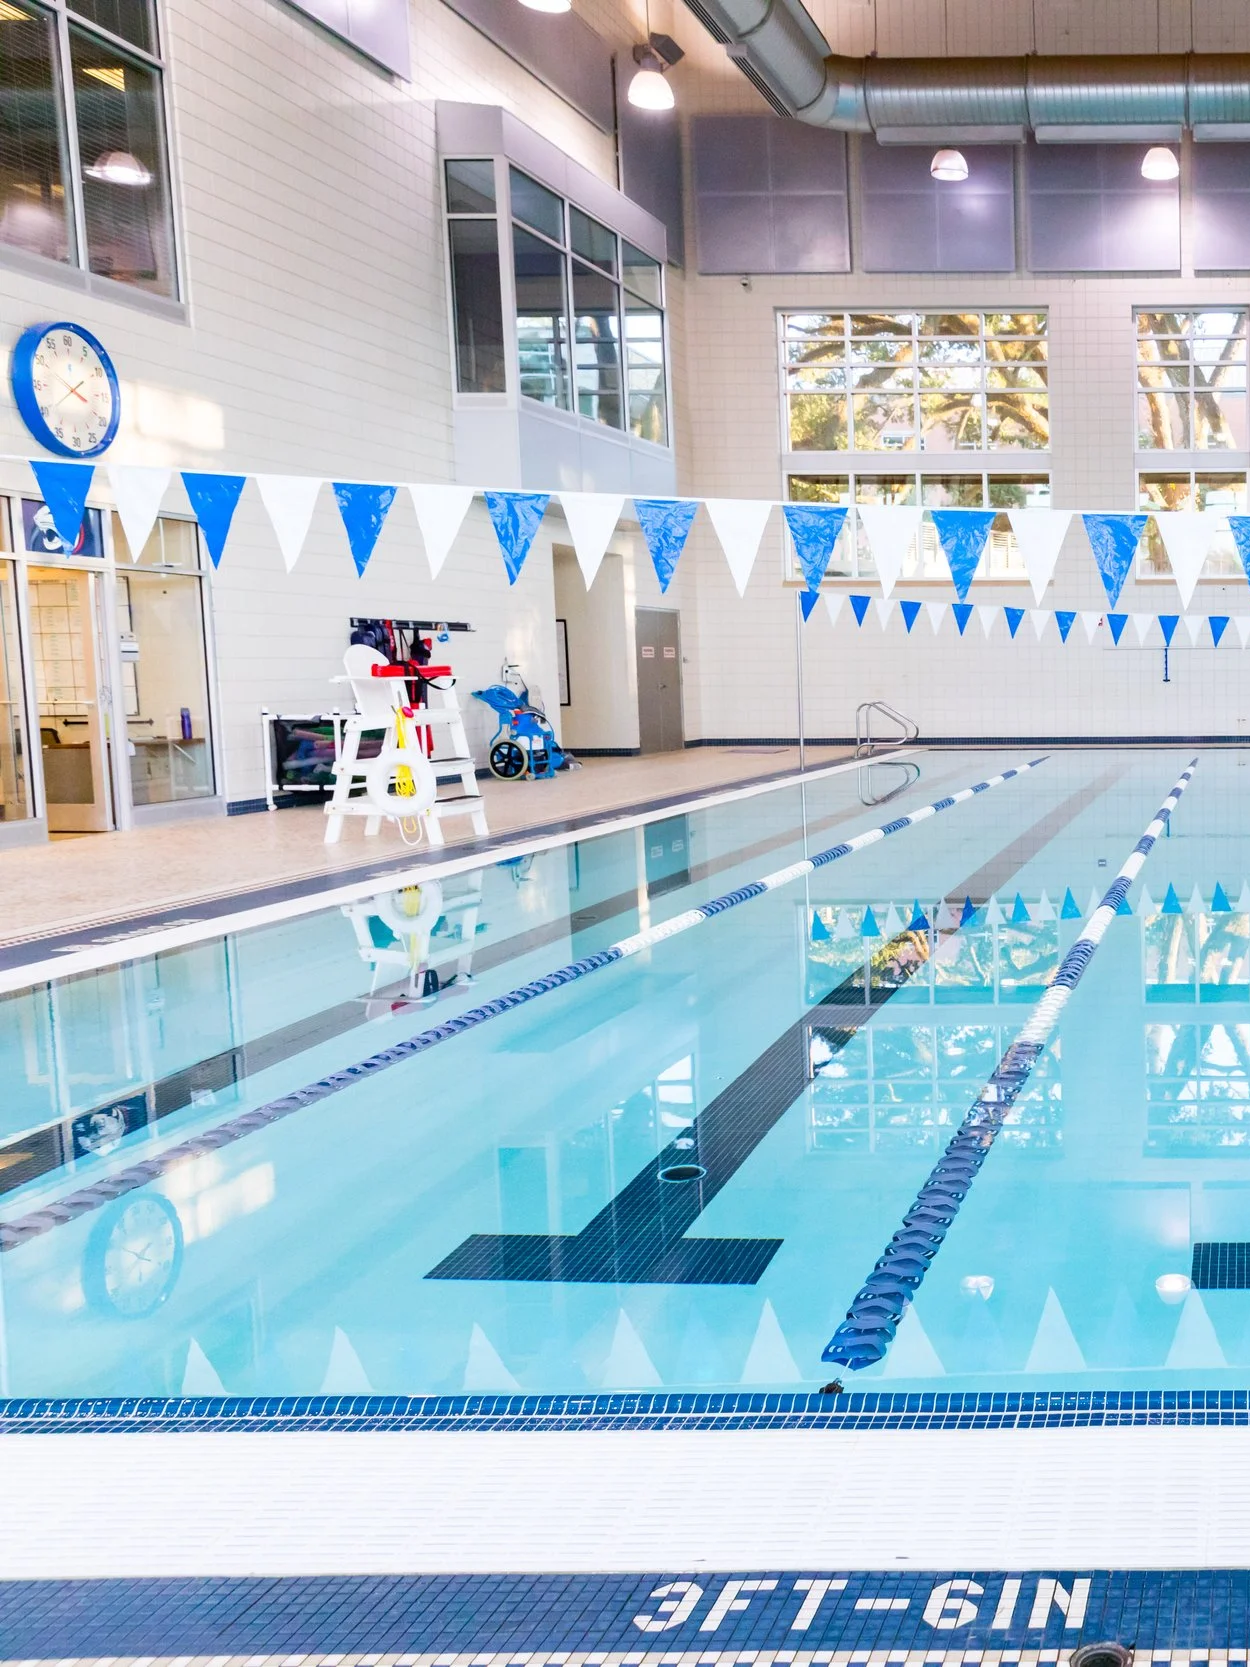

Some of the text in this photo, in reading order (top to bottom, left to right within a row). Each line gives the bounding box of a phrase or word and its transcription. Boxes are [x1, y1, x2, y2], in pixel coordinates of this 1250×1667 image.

[46, 337, 56, 350] 55
[63, 335, 72, 347] 60
[81, 346, 88, 357] 5
[94, 367, 103, 378] 10
[100, 392, 110, 403] 15
[98, 416, 107, 427] 20
[54, 427, 64, 439] 35
[88, 432, 97, 444] 25
[72, 436, 81, 448] 30
